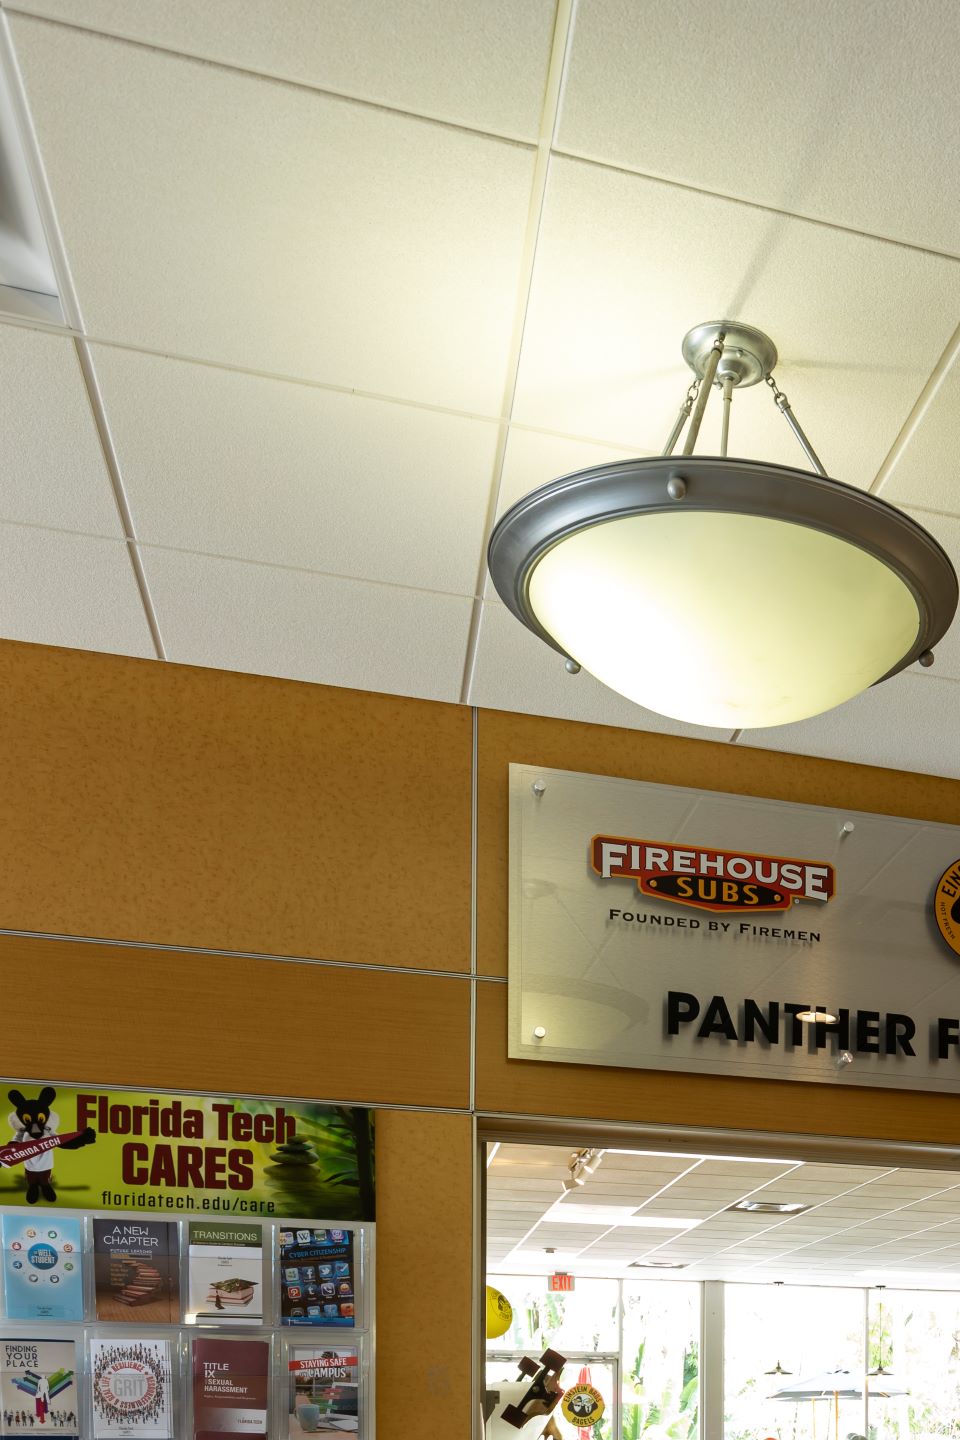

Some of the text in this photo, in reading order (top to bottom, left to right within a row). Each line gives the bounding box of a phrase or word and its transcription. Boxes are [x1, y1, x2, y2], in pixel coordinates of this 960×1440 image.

[601, 842, 828, 901] FIREHOUSE
[676, 877, 760, 905] SUBS
[609, 909, 821, 943] FOUNDED BY FIREMEN
[668, 991, 916, 1056] PANTHER
[77, 1094, 296, 1144] Florida Tech
[4, 1136, 61, 1162] FLORIDA TECH
[122, 1142, 253, 1191] CARES
[101, 1190, 275, 1213] floridatech.edu/care
[112, 1226, 149, 1236] A NEW
[193, 1230, 258, 1241] TRANSITIONS
[103, 1235, 159, 1247] CHAPTER
[552, 1275, 571, 1291] EXIT
[5, 1345, 37, 1353] FINDING
[7, 1352, 38, 1360] YOUR
[6, 1360, 39, 1368] PLACE
[203, 1362, 229, 1371] TITLE
[300, 1357, 347, 1369] STAYING SAFE
[204, 1370, 216, 1378] IX
[308, 1367, 346, 1378] CAMPUS
[113, 1379, 146, 1397] GRIT
[207, 1378, 233, 1387] SEXUAL
[204, 1386, 248, 1394] HARASSMENT
[572, 1416, 595, 1425] BAGELS
